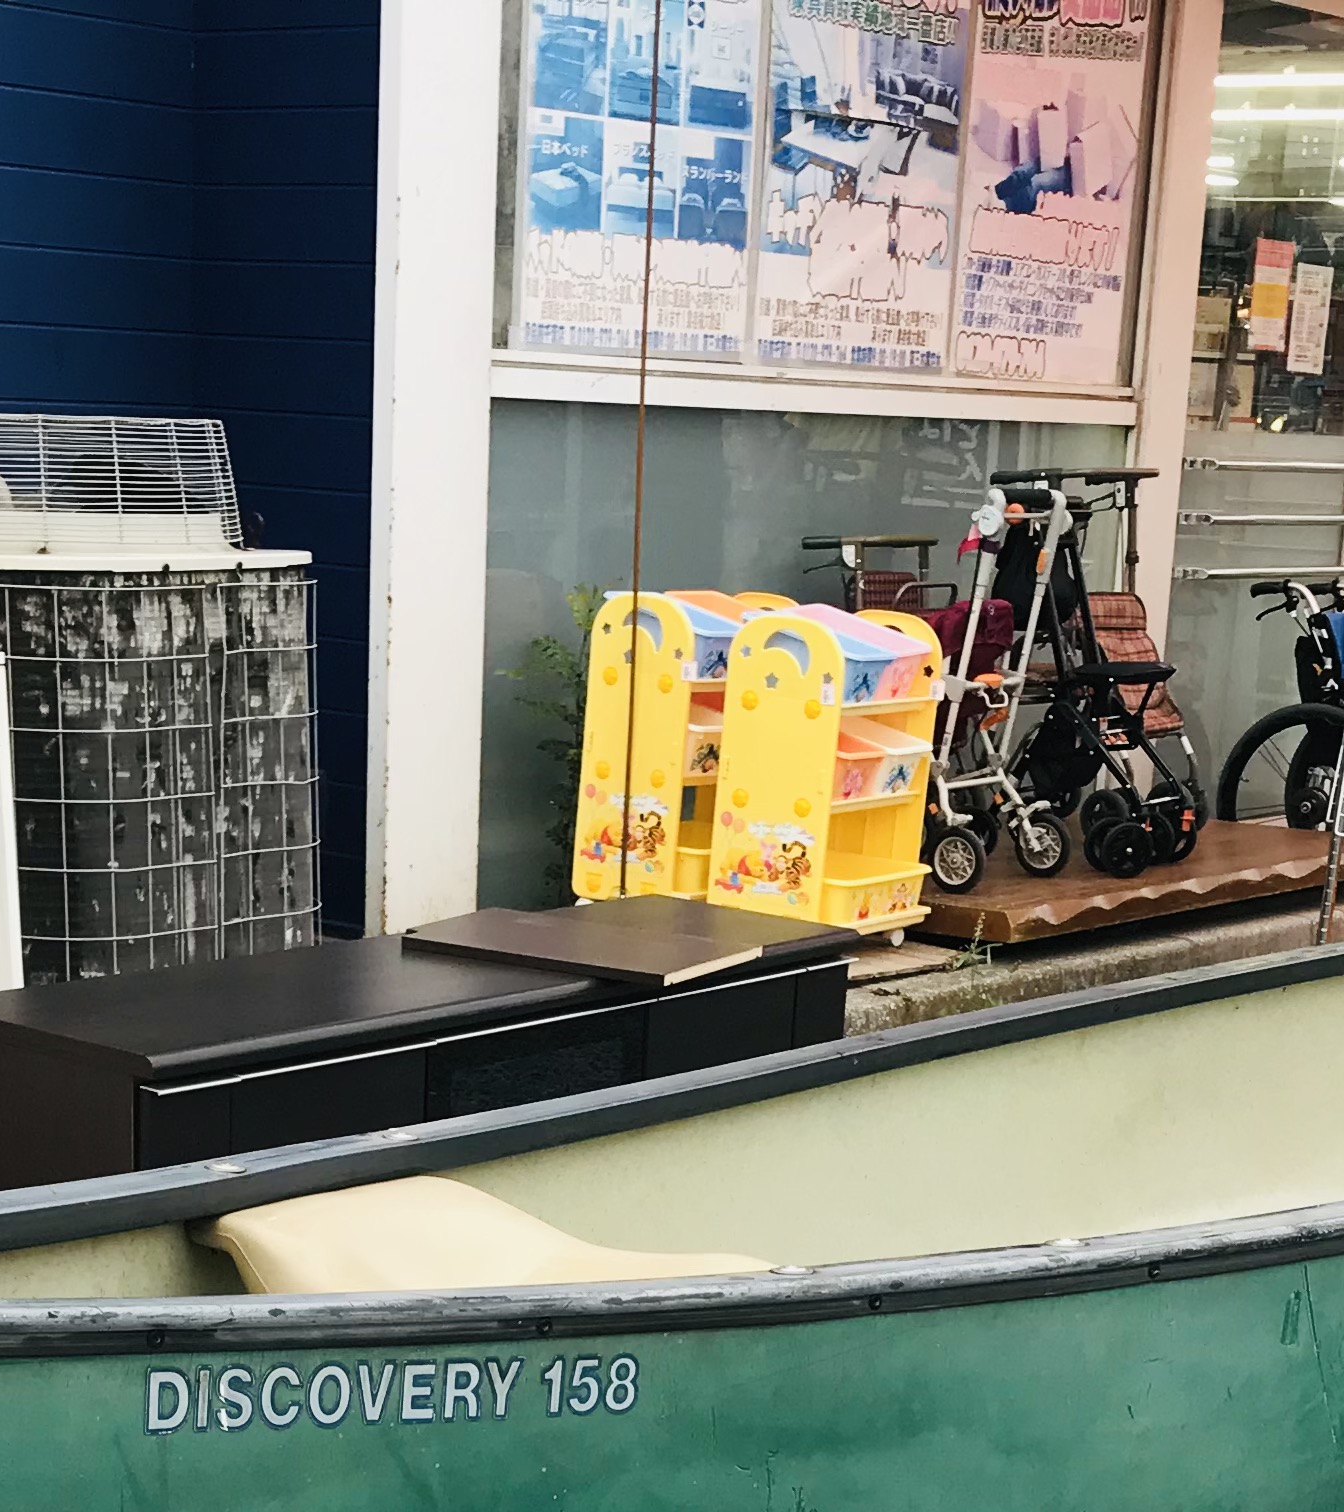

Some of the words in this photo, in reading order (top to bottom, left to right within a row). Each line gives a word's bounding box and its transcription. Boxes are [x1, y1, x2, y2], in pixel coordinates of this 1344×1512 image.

[541, 139, 590, 158] 日本ベッド
[143, 1355, 525, 1436] DISCOVERY
[541, 1352, 641, 1419] 158
